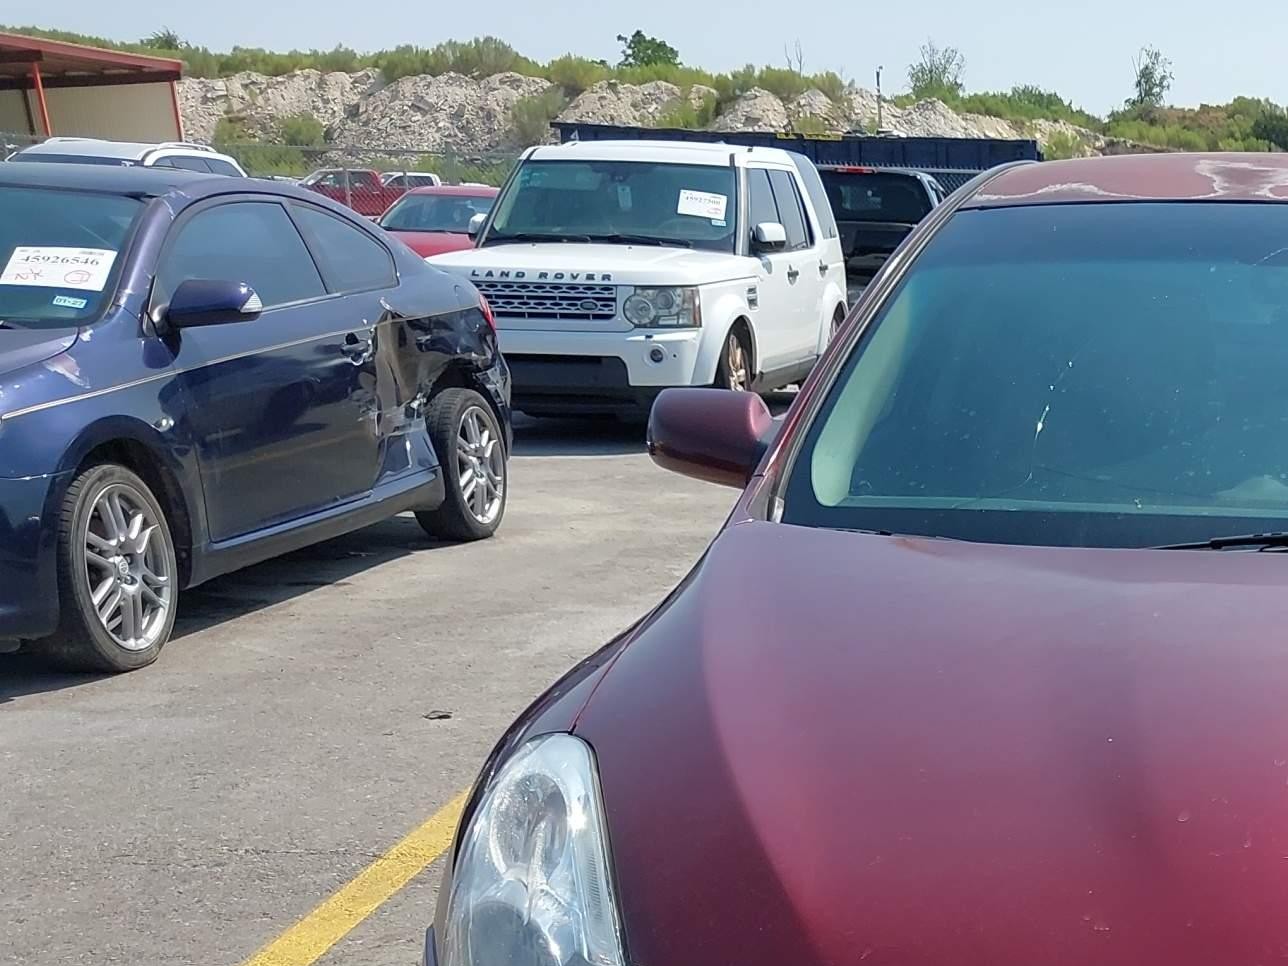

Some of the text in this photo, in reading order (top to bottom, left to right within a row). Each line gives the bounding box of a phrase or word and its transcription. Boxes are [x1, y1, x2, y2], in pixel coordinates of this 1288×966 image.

[19, 255, 100, 266] 45926546
[471, 269, 612, 281] LAND ROVER
